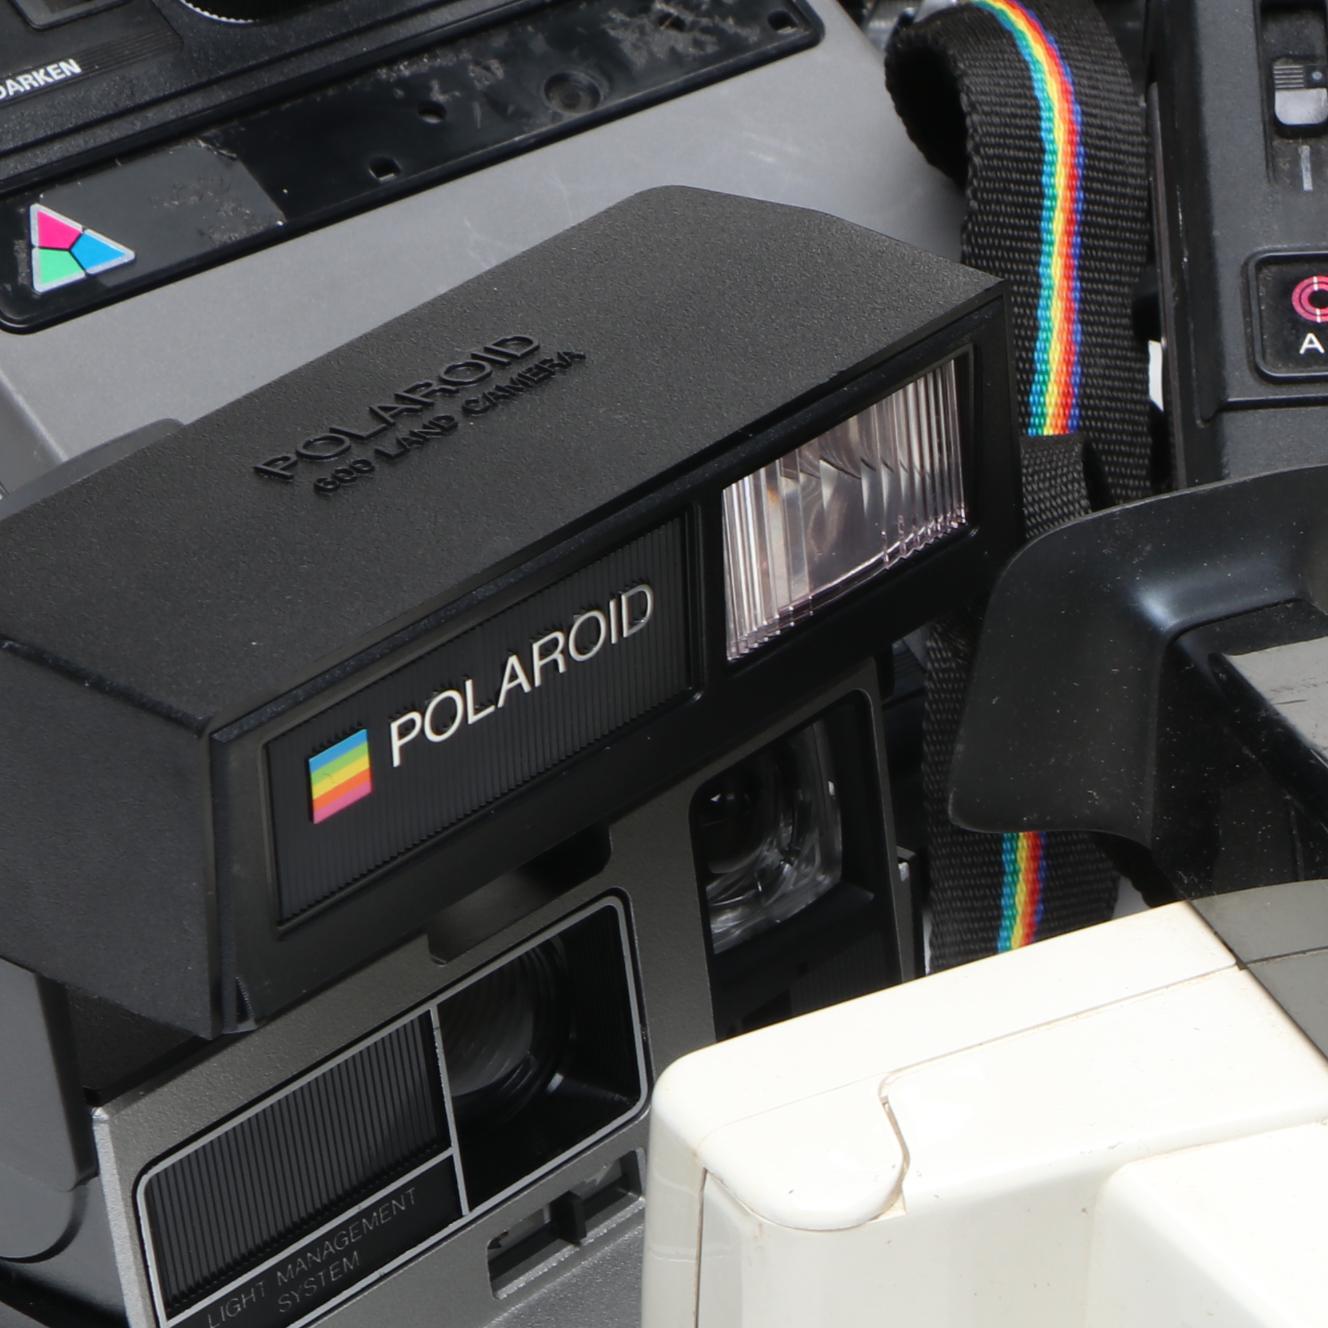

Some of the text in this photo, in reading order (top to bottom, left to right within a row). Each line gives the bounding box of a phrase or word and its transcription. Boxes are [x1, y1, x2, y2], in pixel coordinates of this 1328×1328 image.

[1300, 332, 1325, 354] A
[253, 335, 541, 480] POLAROID
[313, 349, 586, 494] 600 LAND CAMERA
[389, 583, 653, 768] POLAROID
[276, 1187, 416, 1286] MANAGEMENT
[277, 1251, 360, 1313] SYSTEM
